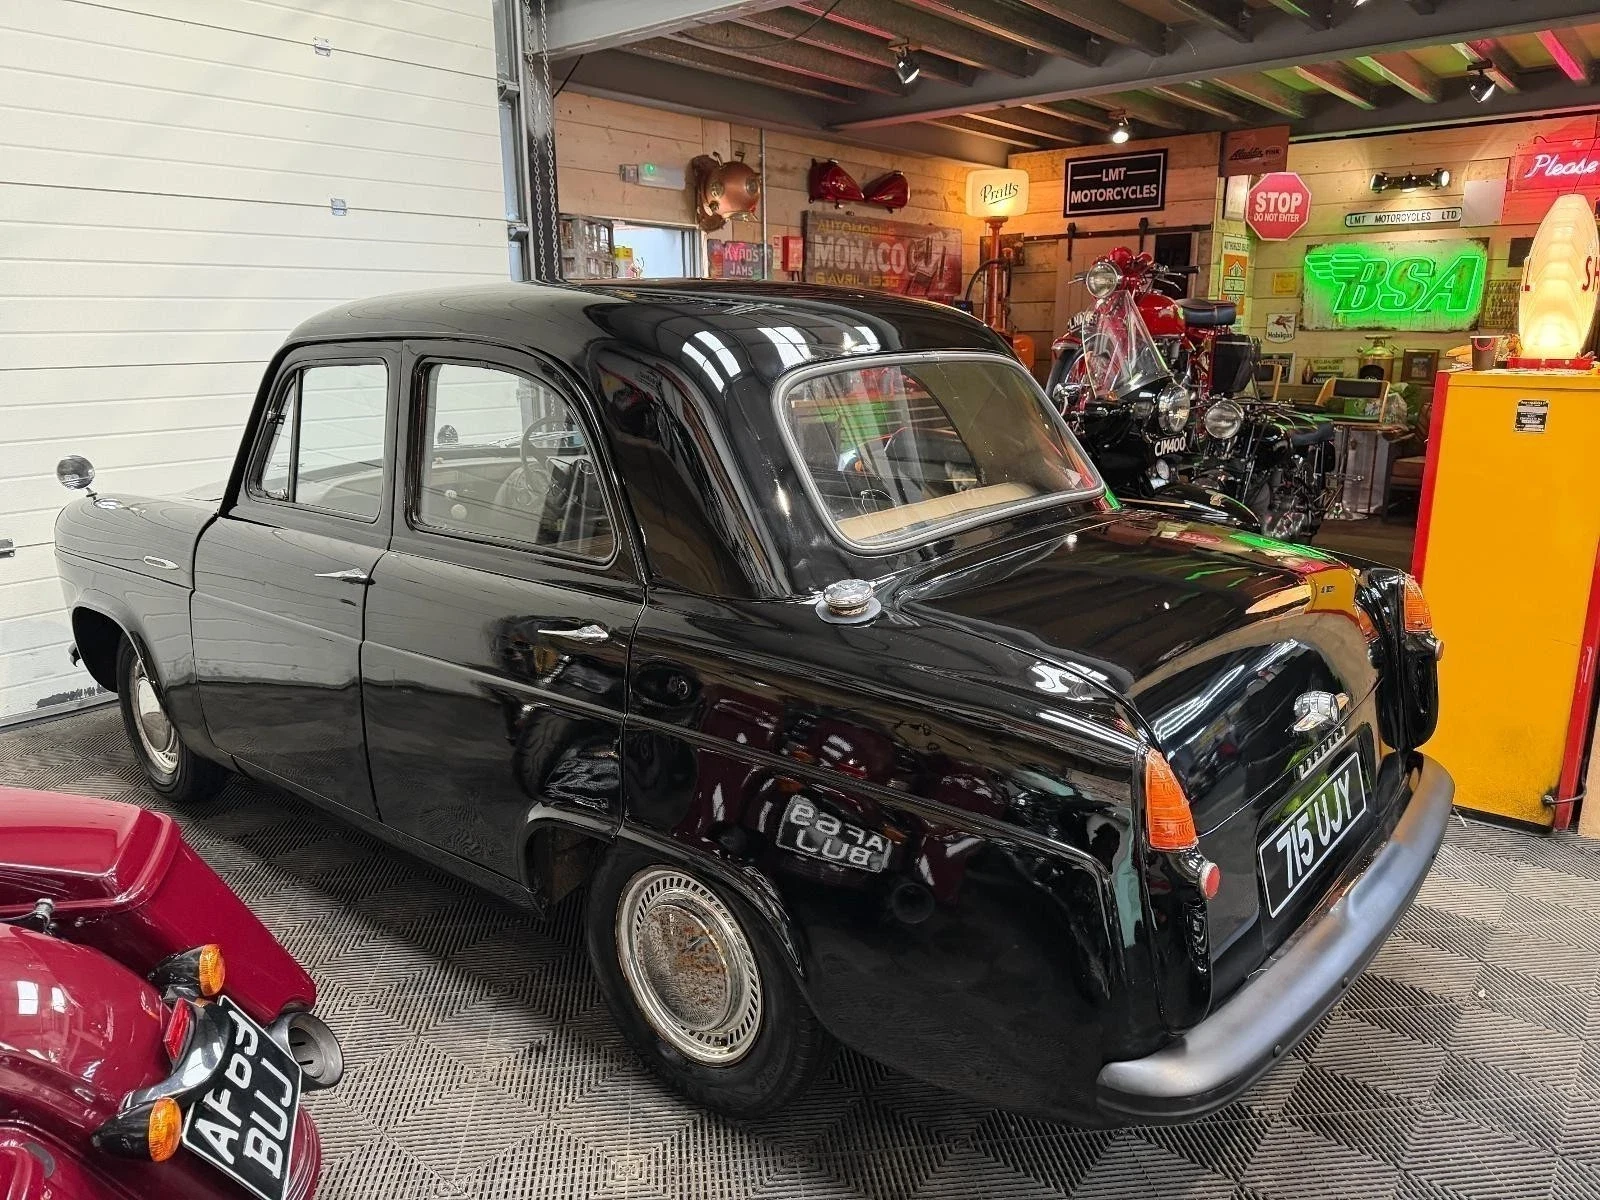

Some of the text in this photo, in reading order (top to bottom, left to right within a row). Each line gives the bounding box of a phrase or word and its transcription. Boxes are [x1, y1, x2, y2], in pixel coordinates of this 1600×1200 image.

[1102, 167, 1127, 182] LMT
[1523, 153, 1599, 179] Please
[1070, 184, 1157, 204] MOTORCYCLES
[1254, 191, 1303, 213] STOP
[1253, 213, 1300, 222] DO NOT ENTER
[1349, 210, 1457, 225] LMT MOTORCYCLES LTD
[814, 234, 906, 274] MONACO
[729, 263, 753, 276] JAMS
[825, 274, 861, 286] AVRIL
[1333, 255, 1481, 313] BSA
[1276, 765, 1353, 889] 715 UJY
[242, 1057, 293, 1180] BUJ
